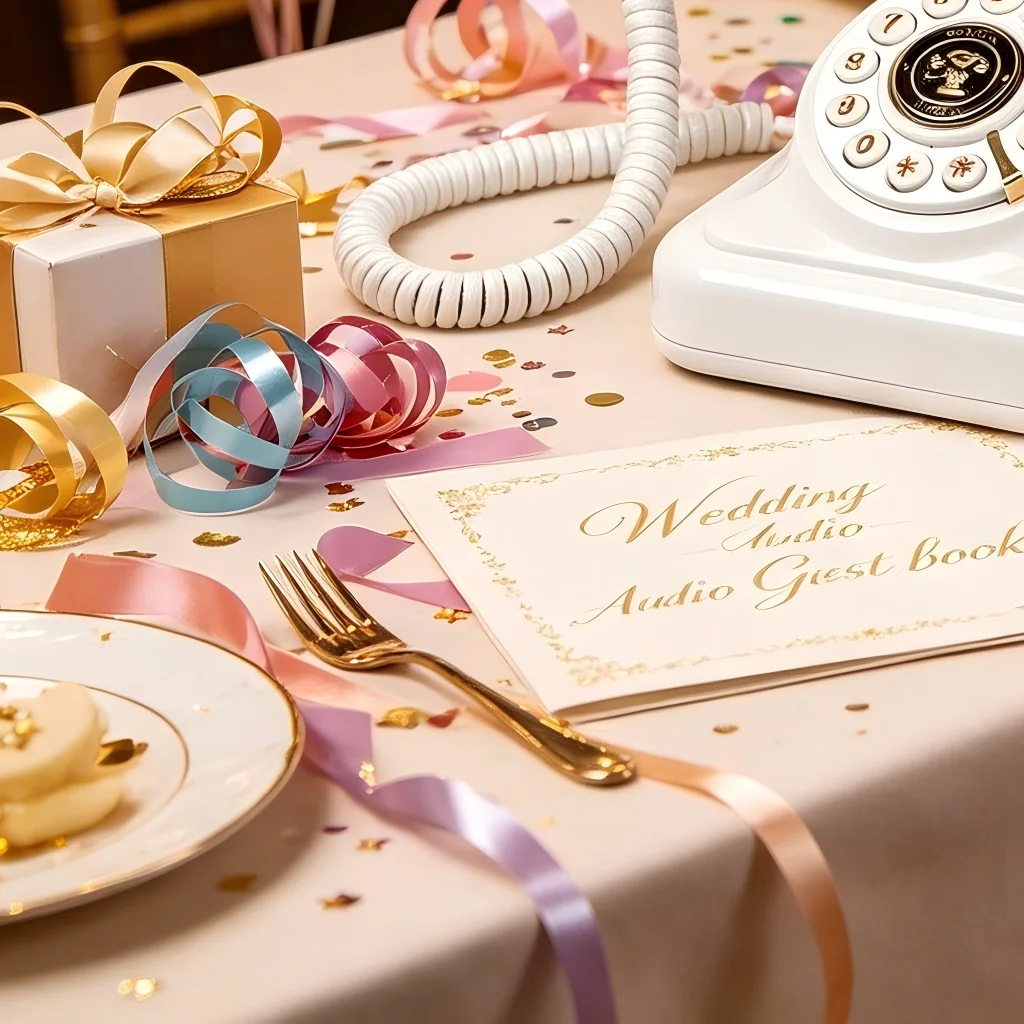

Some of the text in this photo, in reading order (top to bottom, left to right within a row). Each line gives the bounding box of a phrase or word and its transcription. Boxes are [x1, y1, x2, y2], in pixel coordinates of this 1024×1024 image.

[884, 13, 904, 33] 7
[856, 135, 875, 154] 0
[580, 475, 886, 544] Wedding
[570, 580, 735, 627] Audio
